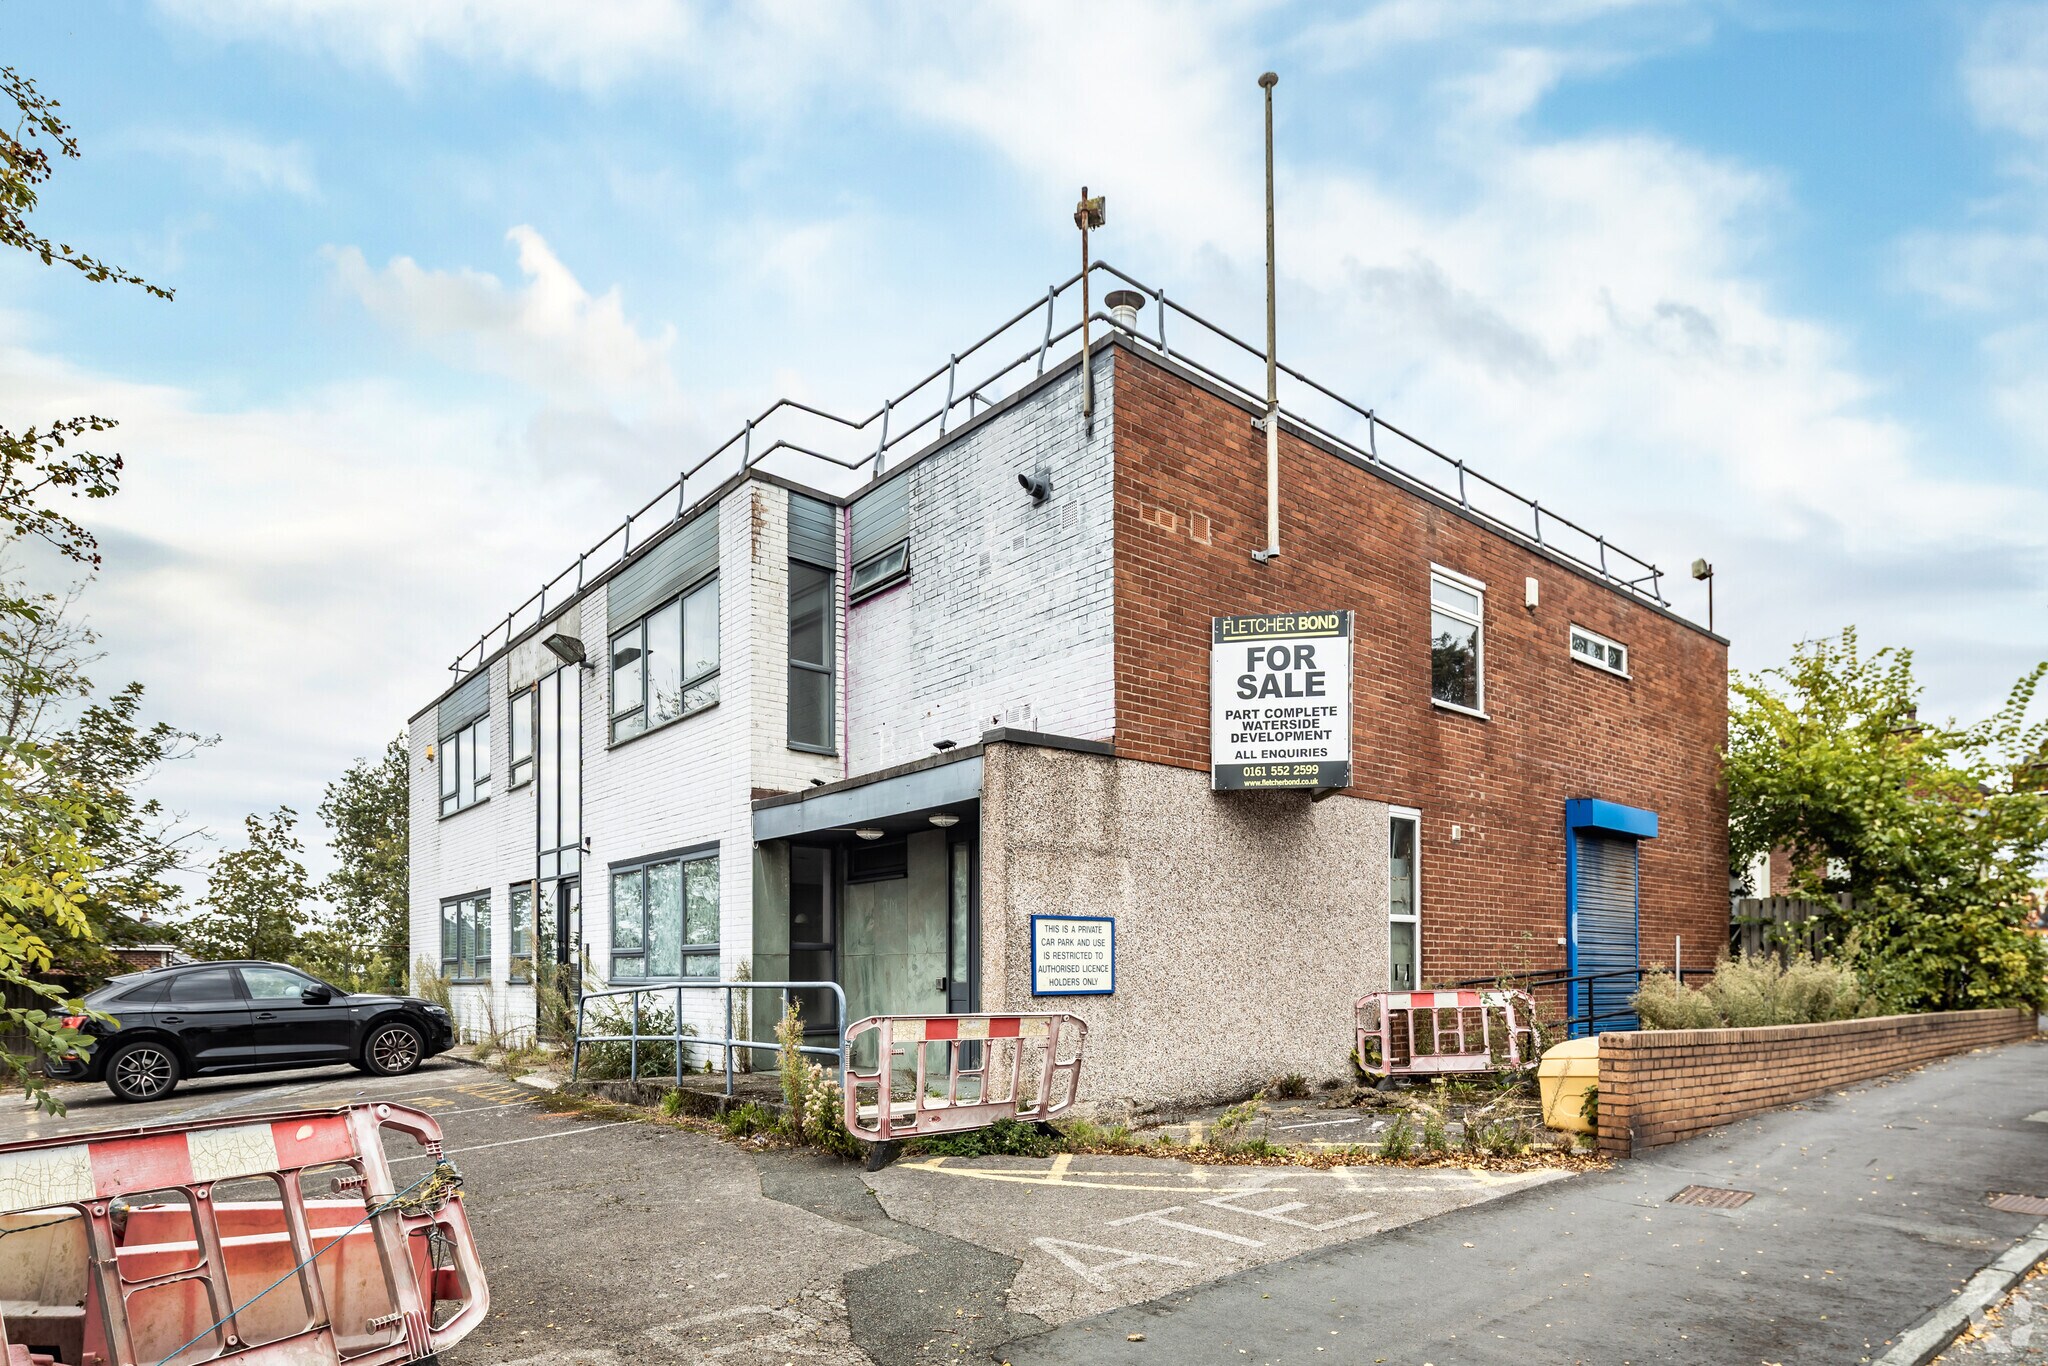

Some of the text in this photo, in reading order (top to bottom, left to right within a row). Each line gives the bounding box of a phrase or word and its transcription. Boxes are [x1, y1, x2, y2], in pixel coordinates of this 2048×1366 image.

[1223, 615, 1339, 634] FLETCHER BOND
[1247, 645, 1317, 672] FOR
[1237, 671, 1325, 700] SALE
[1226, 706, 1337, 720] PART COMPLETE
[1242, 719, 1320, 731] WATERSIDE
[1231, 730, 1332, 743] DEVELOPMENT
[1235, 748, 1328, 759] ALL ENQUIRIES
[1244, 765, 1319, 776] 0161 552 2599
[1244, 778, 1318, 786] www.fletcherbond.co.uk
[1045, 925, 1059, 933] THIS
[1062, 925, 1068, 933] IS
[1041, 938, 1055, 946] CAR
[1038, 965, 1080, 973] AUTHORISED
[1050, 978, 1080, 986] HOLDERS
